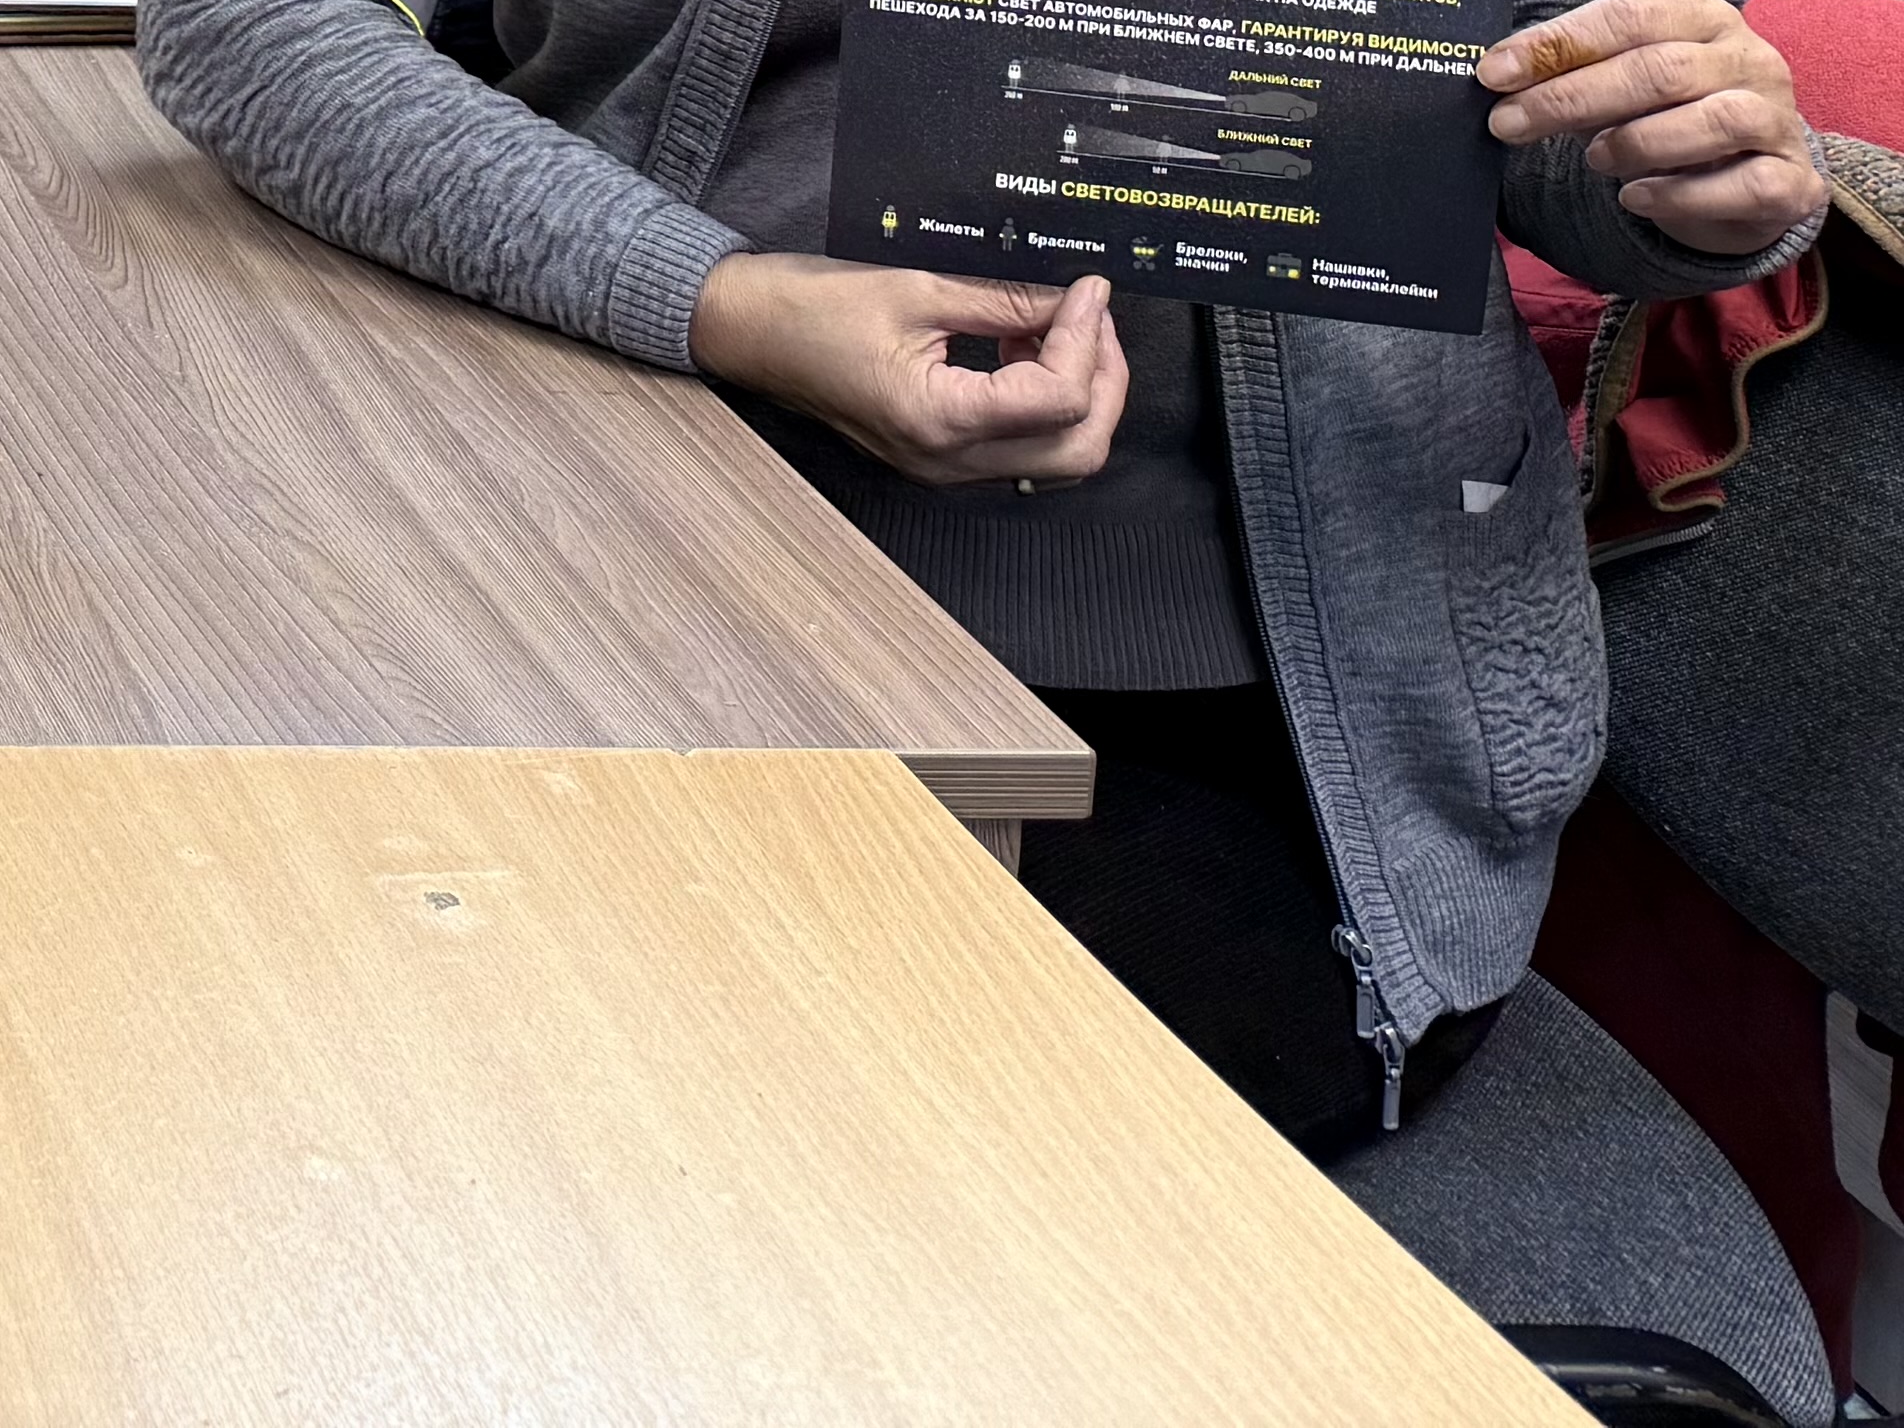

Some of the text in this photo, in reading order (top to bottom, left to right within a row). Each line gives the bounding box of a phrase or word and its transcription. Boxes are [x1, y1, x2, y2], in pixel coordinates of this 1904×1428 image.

[1043, 0, 1194, 29] АВТОМОБИЛЬНЫХ
[1197, 17, 1236, 35] ФАР,
[1241, 20, 1364, 48] ГАРАНТИРУЯ
[964, 7, 986, 22] ЗА
[991, 10, 1055, 30] 150-200
[1058, 19, 1074, 32] М
[1077, 21, 1110, 36] ПРИ
[1113, 24, 1200, 46] БЛИЖНЕМ
[1203, 35, 1260, 55] СВЕТЕ,
[1263, 41, 1336, 62] 350-400
[1339, 50, 1355, 64] М
[1357, 51, 1393, 68] ПРИ
[1228, 70, 1323, 90] ДАЛЬНИЙ СВЕТ
[1217, 129, 1313, 149] БЛИЖНИЙ СВЕТ
[995, 172, 1321, 225] ВИДЫ СВЕТОВОЗВРАЩАТЕЛЕЙ:
[919, 217, 985, 240] Жилеты
[1027, 232, 1106, 254] Браслеты
[1175, 242, 1249, 265] Брелоки,
[1174, 256, 1230, 274] значки
[1311, 258, 1391, 282] Нашивки,
[1311, 273, 1440, 301] термонаклейки
